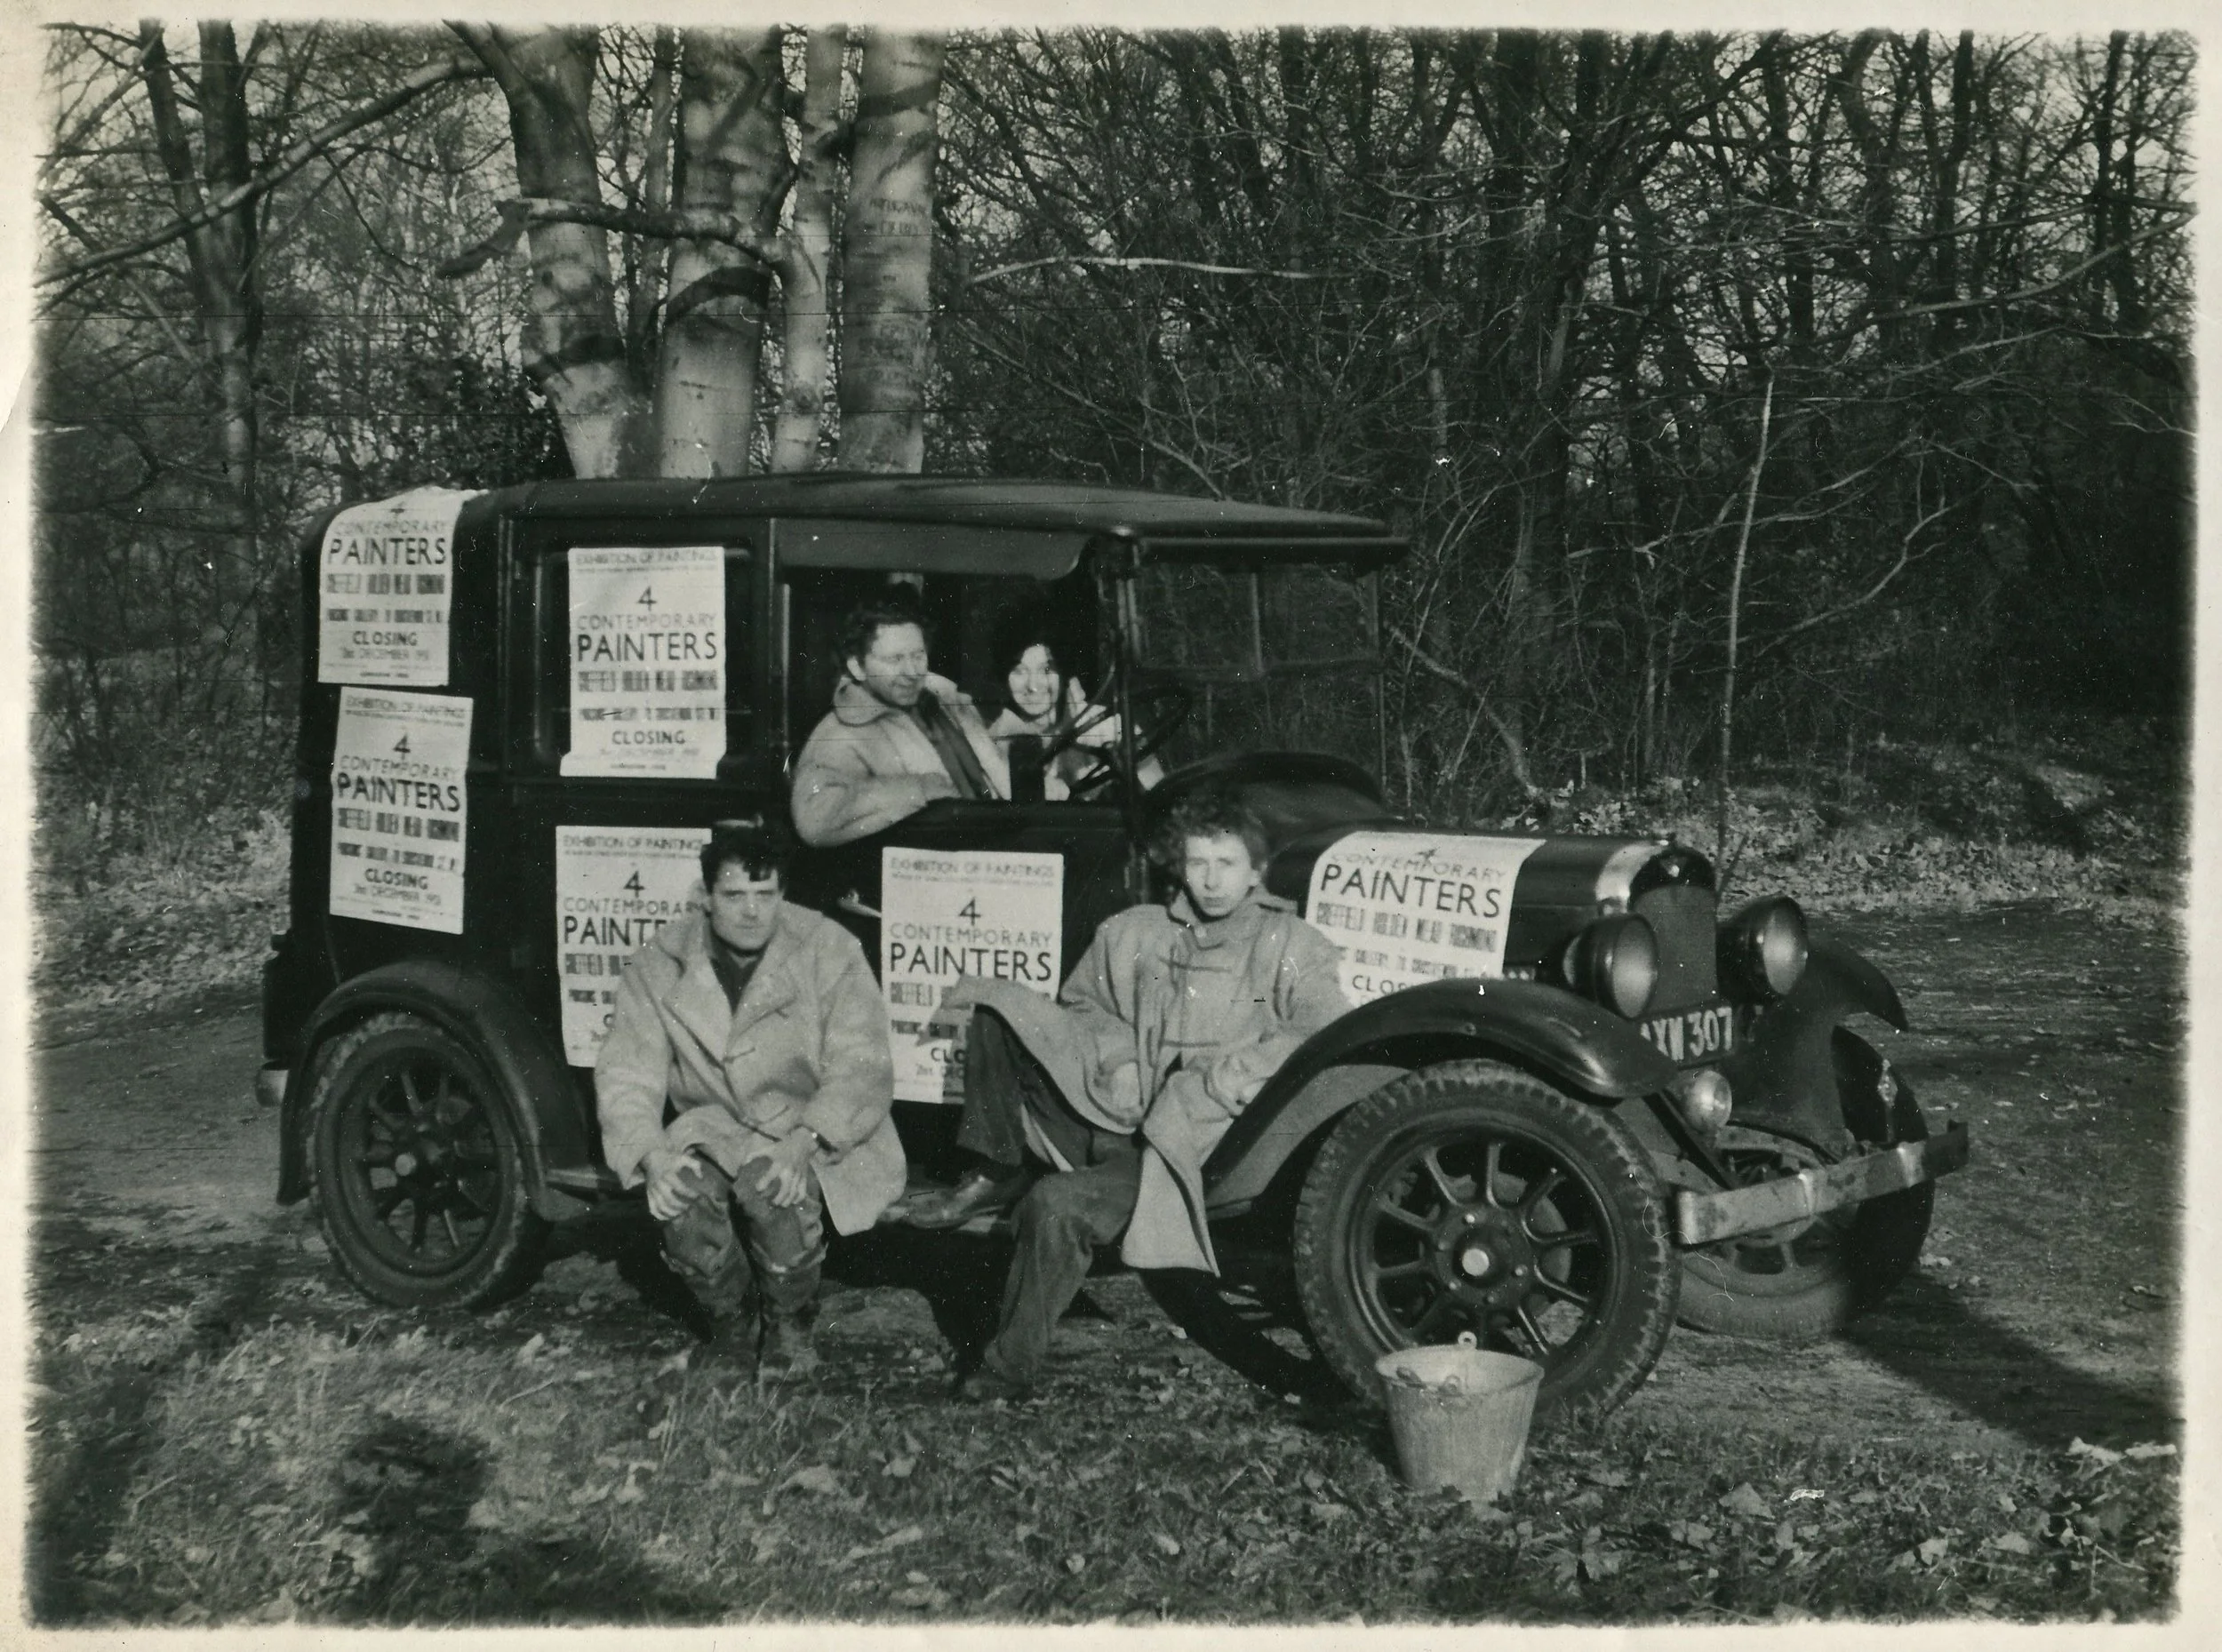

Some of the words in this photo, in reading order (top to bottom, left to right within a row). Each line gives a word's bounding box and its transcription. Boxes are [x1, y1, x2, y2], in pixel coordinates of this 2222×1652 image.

[328, 538, 446, 565] PAINTERS
[637, 586, 658, 612] 4
[579, 613, 716, 630] CONTEMPORARY
[353, 630, 418, 647] CLOSING
[578, 632, 717, 662] PAINTERS
[394, 731, 411, 761] 4
[612, 730, 685, 745] CLOSING
[340, 755, 458, 780] CONTEMPORARY
[338, 772, 460, 812] PAINTERS
[563, 834, 622, 848] EXHIBITION
[626, 836, 642, 849] OF
[364, 868, 428, 890] CLOSING
[964, 861, 980, 874] OF
[1331, 852, 1507, 883] CONTEMPORARY
[624, 871, 644, 898] 4
[1321, 864, 1501, 918] PAINTERS
[959, 898, 981, 926] 4
[891, 922, 1052, 947] CONTEMPORARY
[891, 943, 1052, 981] PAINTERS
[1688, 1006, 1732, 1057] 307
